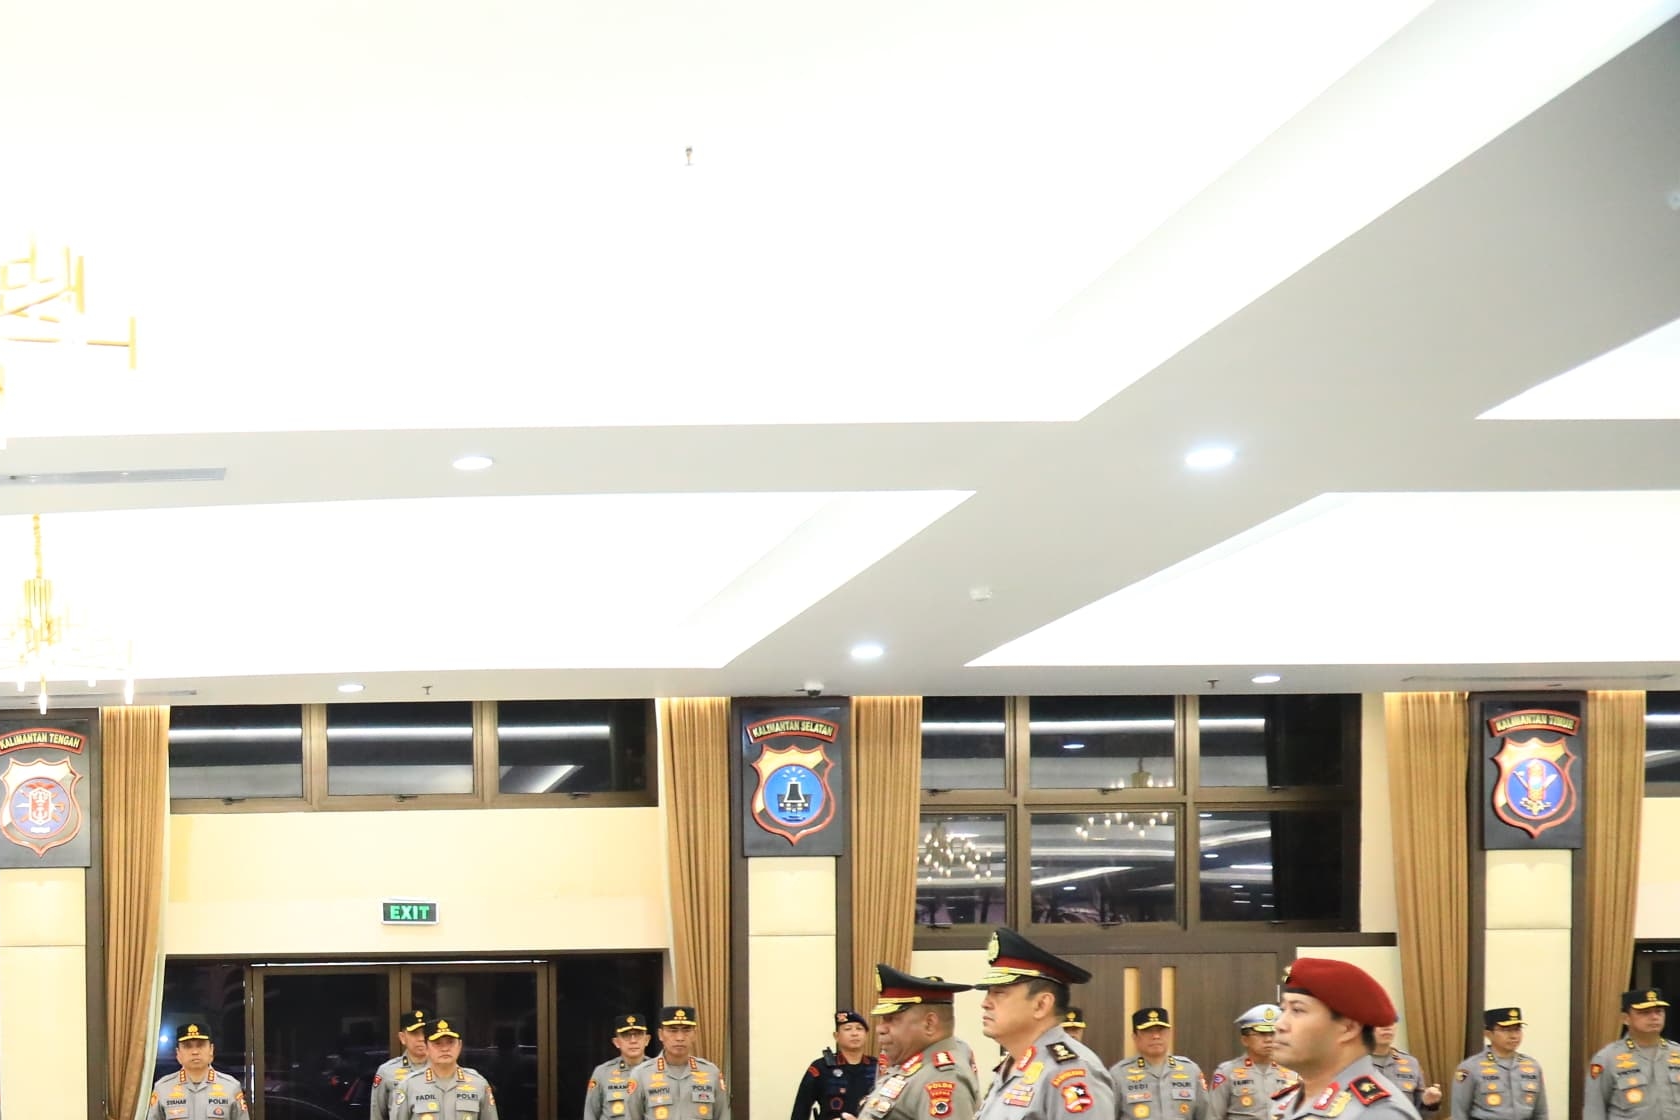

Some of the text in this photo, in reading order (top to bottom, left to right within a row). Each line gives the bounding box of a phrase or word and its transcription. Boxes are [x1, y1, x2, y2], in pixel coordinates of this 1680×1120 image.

[752, 721, 834, 738] KALIMANTAN SELATAN
[49, 733, 81, 748] TENGAH
[389, 905, 430, 920] EXIT
